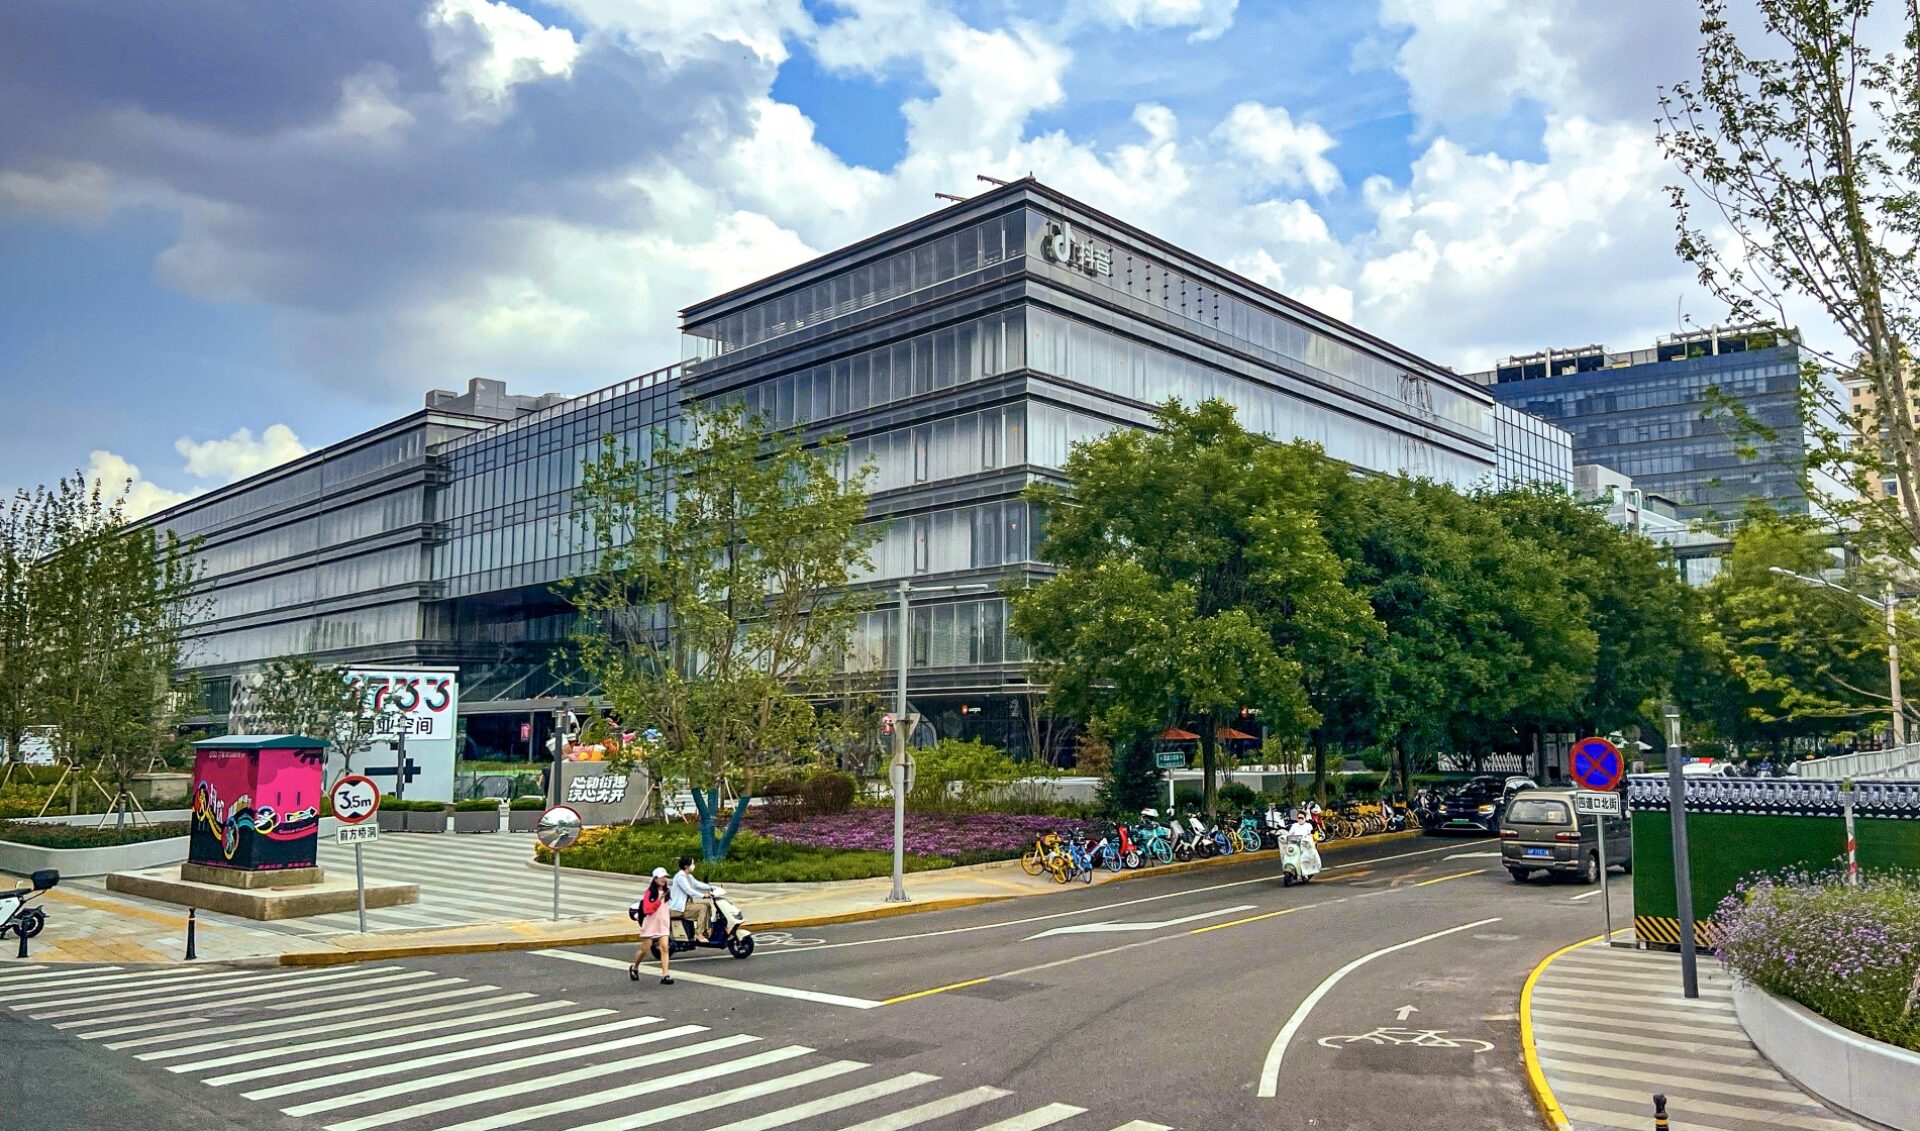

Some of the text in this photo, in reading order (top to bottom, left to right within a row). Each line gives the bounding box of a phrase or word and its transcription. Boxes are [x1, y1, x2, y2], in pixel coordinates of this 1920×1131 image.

[1077, 240, 1111, 276] 抖音
[357, 716, 434, 735] 商业空间
[338, 790, 372, 810] 3.5m
[1578, 796, 1617, 810] 四道口北街
[339, 826, 377, 841] 前方桥洞
